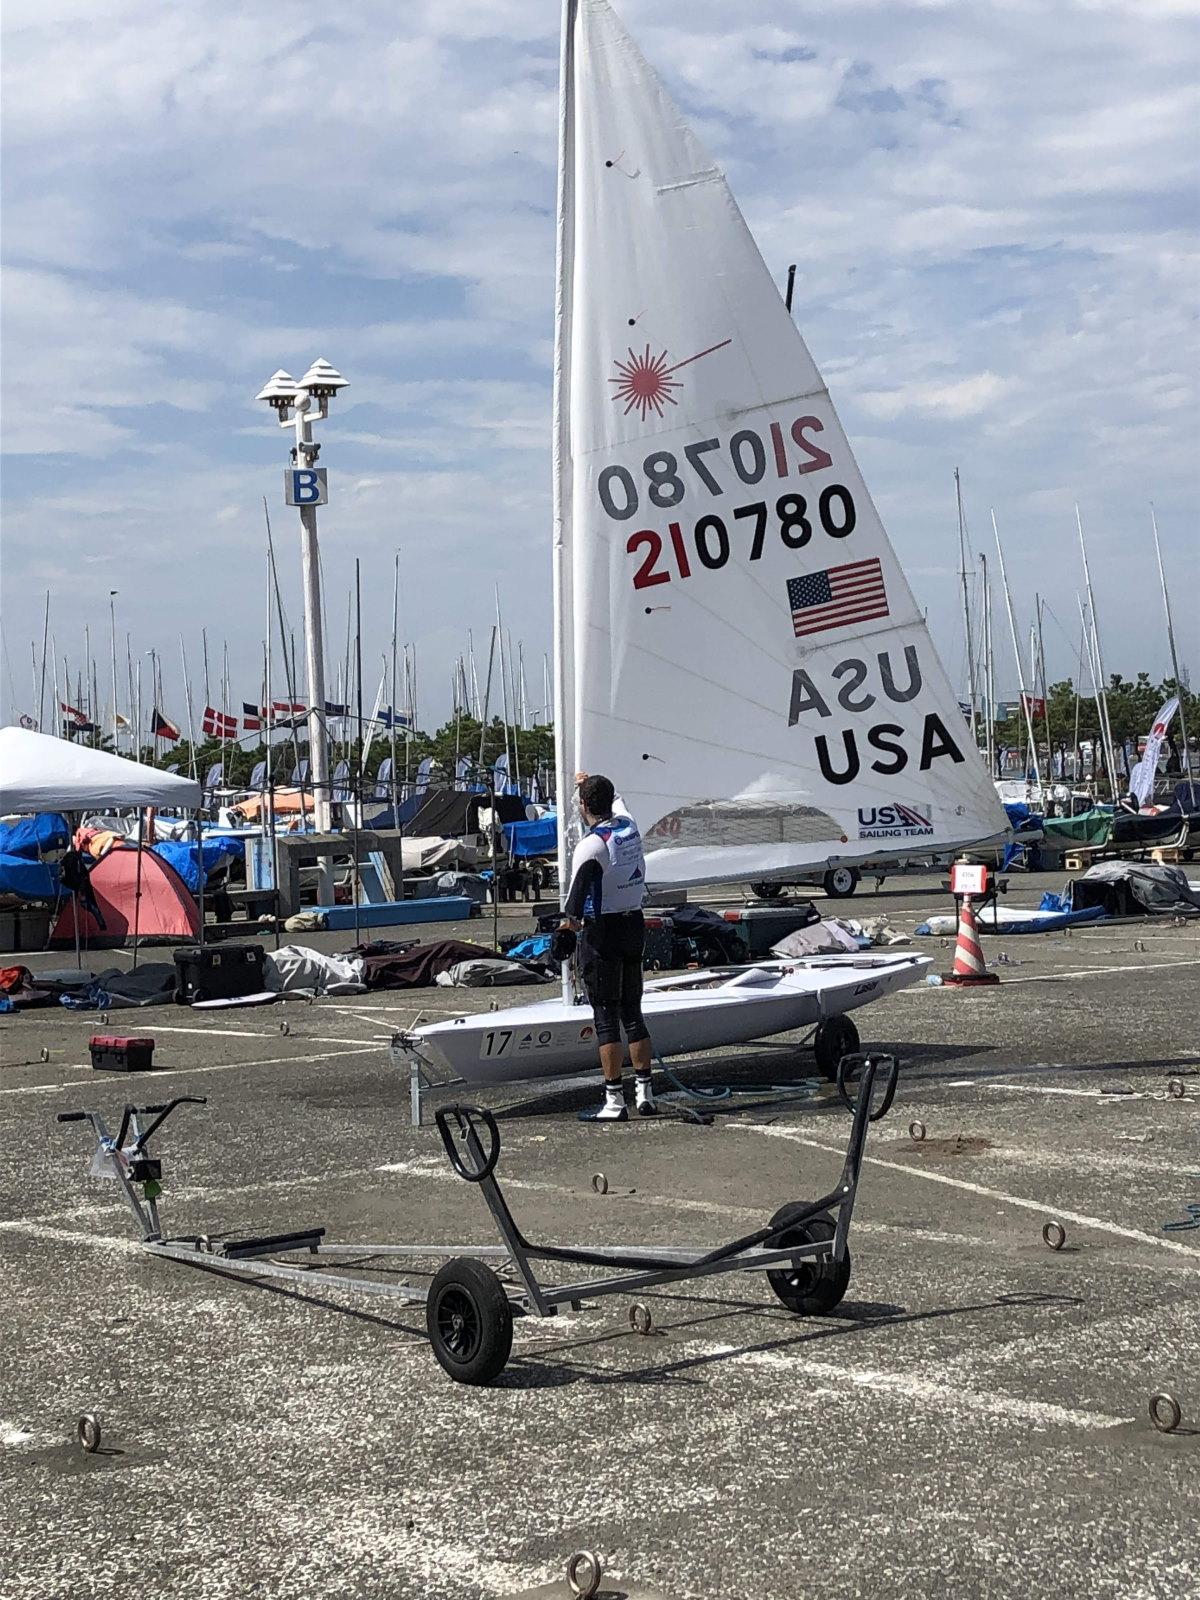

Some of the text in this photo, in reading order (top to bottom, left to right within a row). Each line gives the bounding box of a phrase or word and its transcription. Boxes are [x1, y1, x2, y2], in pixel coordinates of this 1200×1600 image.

[293, 470, 320, 503] B
[626, 484, 856, 590] 210780
[814, 712, 965, 785] USA
[859, 827, 934, 839] SAILING TEAM
[486, 1030, 512, 1056] 17
